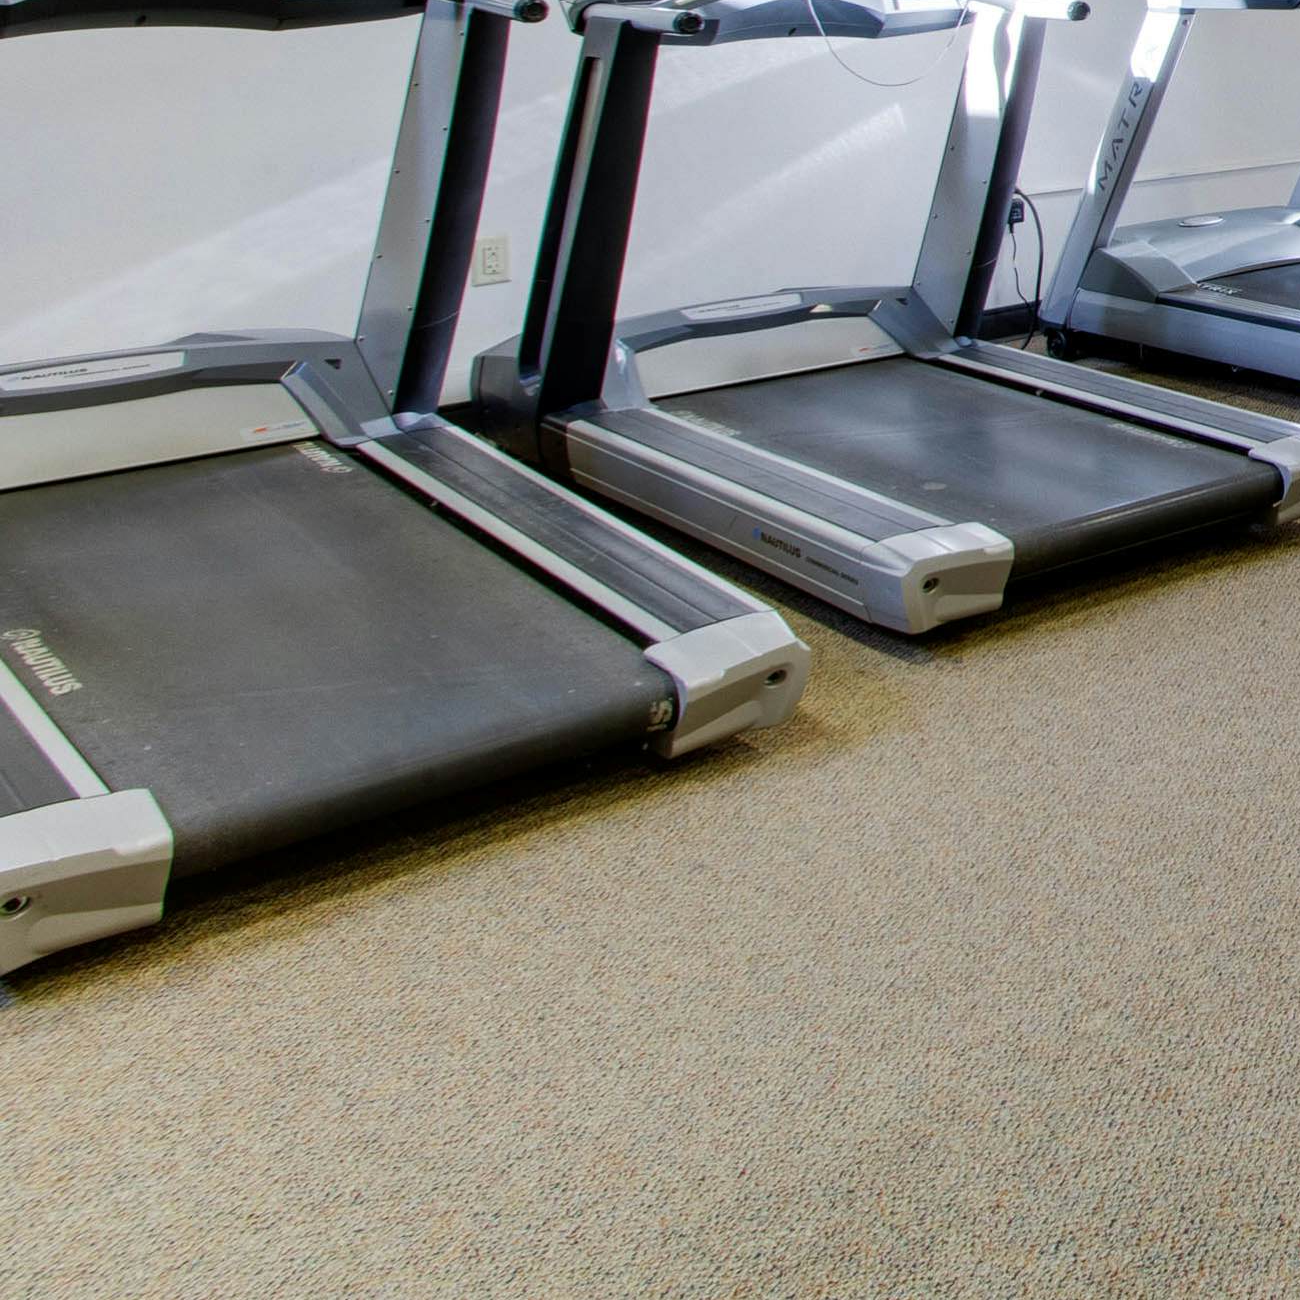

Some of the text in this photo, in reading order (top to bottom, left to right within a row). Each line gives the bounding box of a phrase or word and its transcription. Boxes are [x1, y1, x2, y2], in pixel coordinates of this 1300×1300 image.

[21, 367, 88, 381] NAUTILUS
[761, 531, 802, 558] NAUTILUS
[10, 637, 83, 696] NAUTILUS
